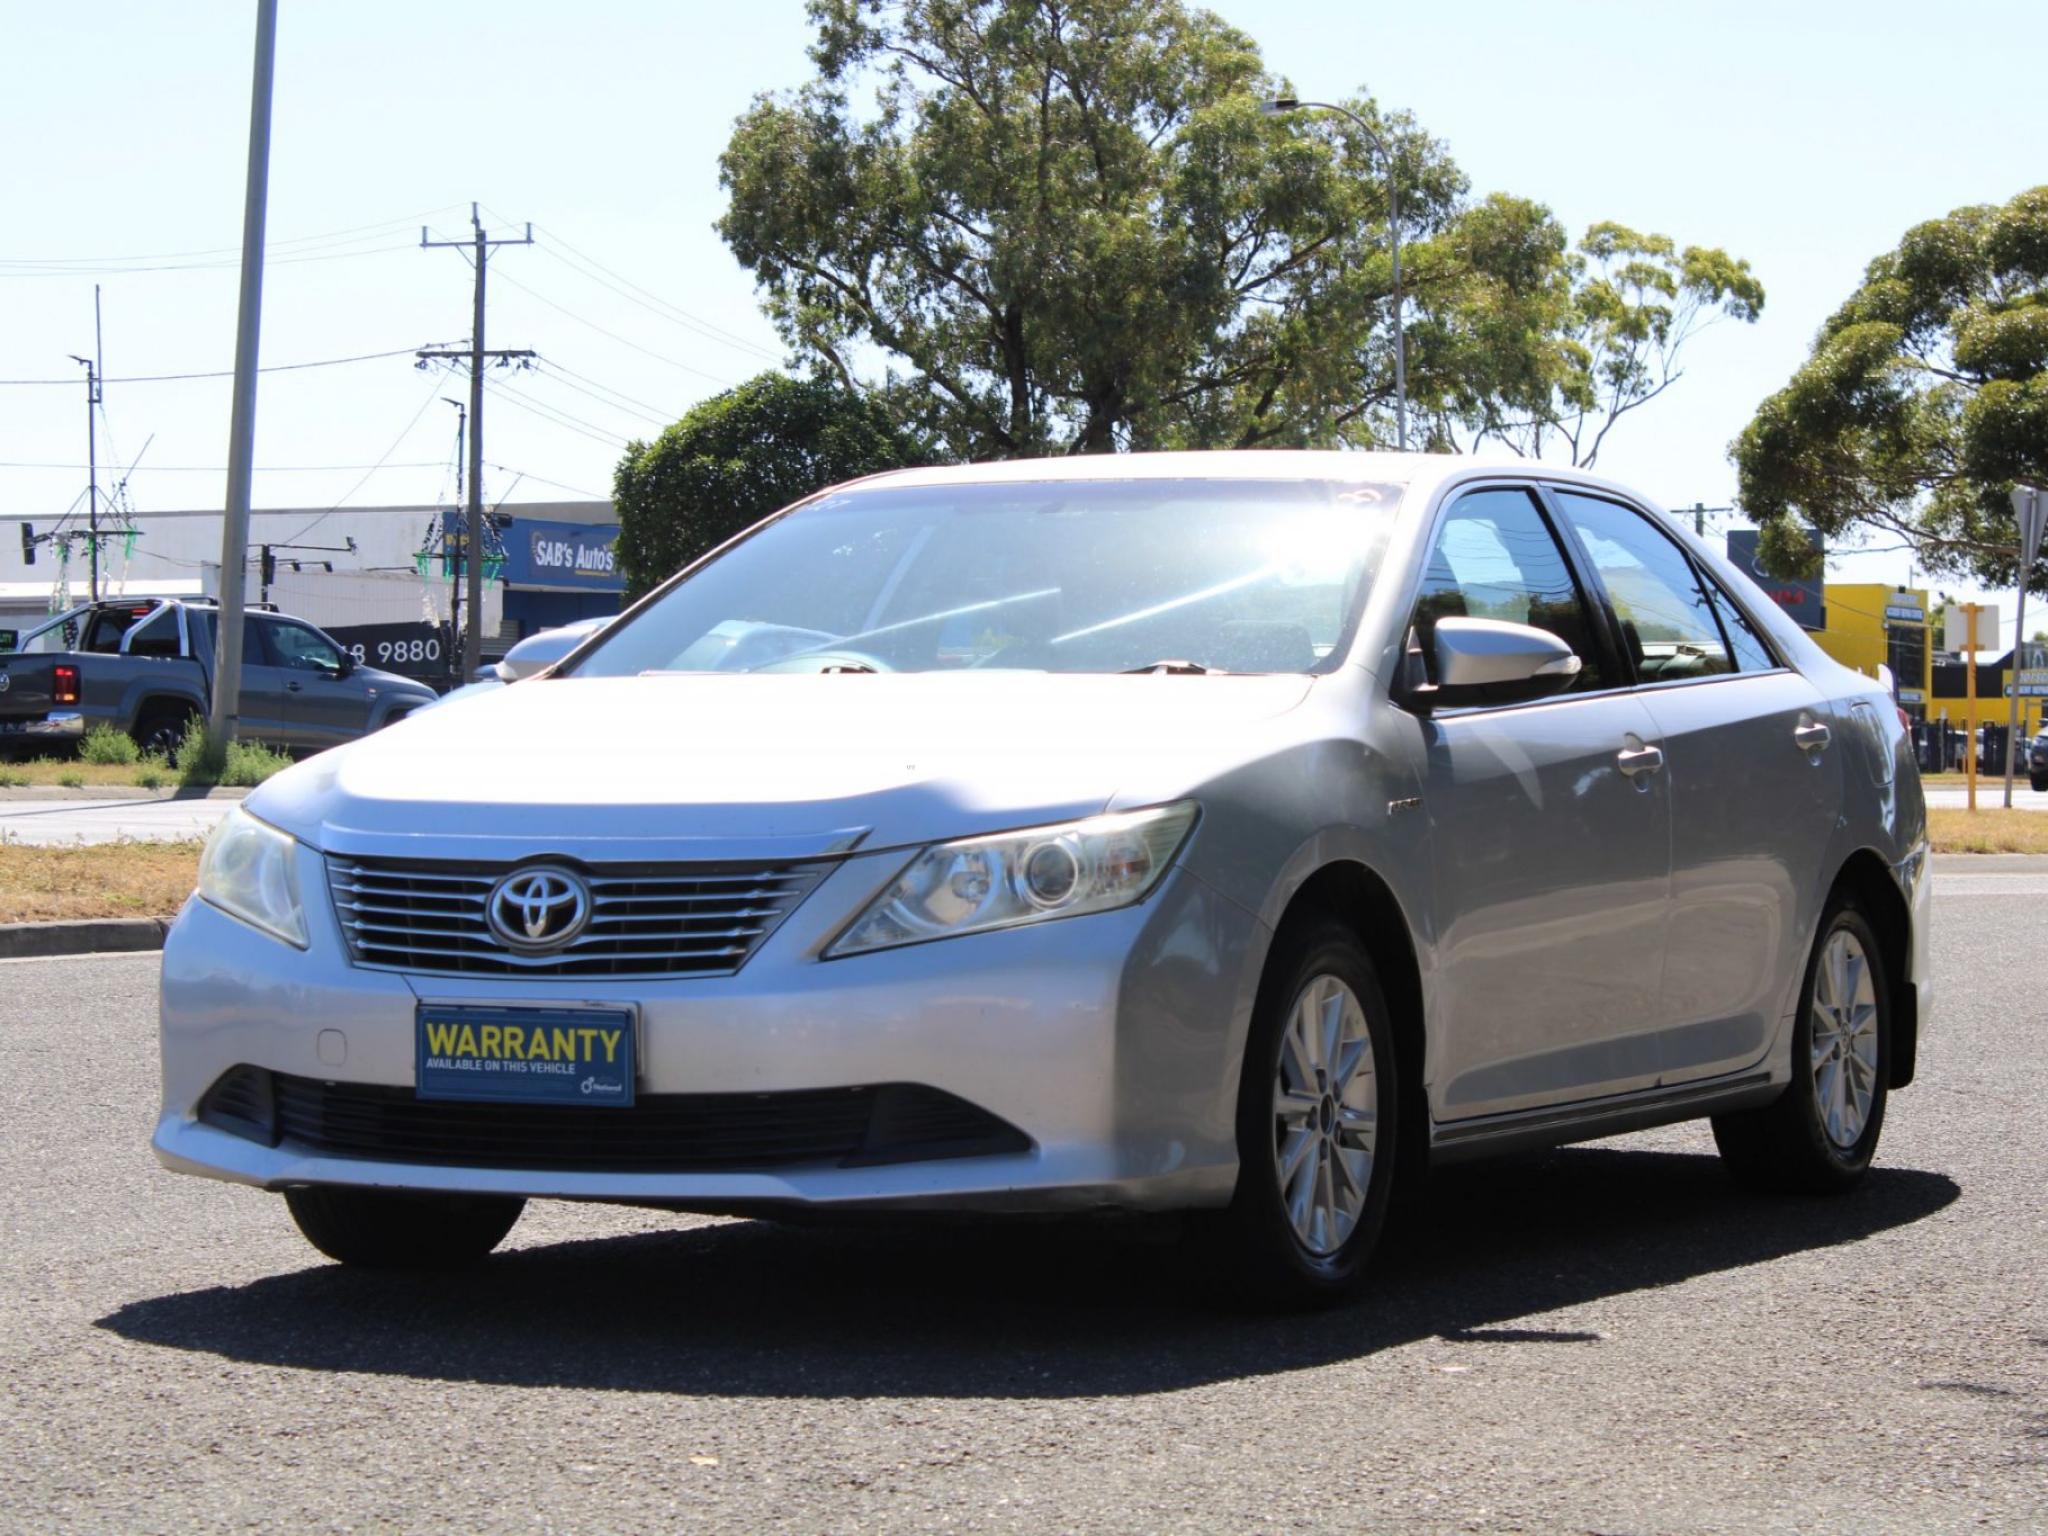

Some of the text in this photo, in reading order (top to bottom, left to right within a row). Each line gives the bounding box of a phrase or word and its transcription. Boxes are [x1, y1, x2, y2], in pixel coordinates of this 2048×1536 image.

[535, 540, 614, 571] SAB's Auto's
[377, 639, 440, 663] 9880
[426, 1023, 621, 1063] WARRANTY
[426, 1058, 576, 1075] AVAILABLE ON THIS VEHICLE
